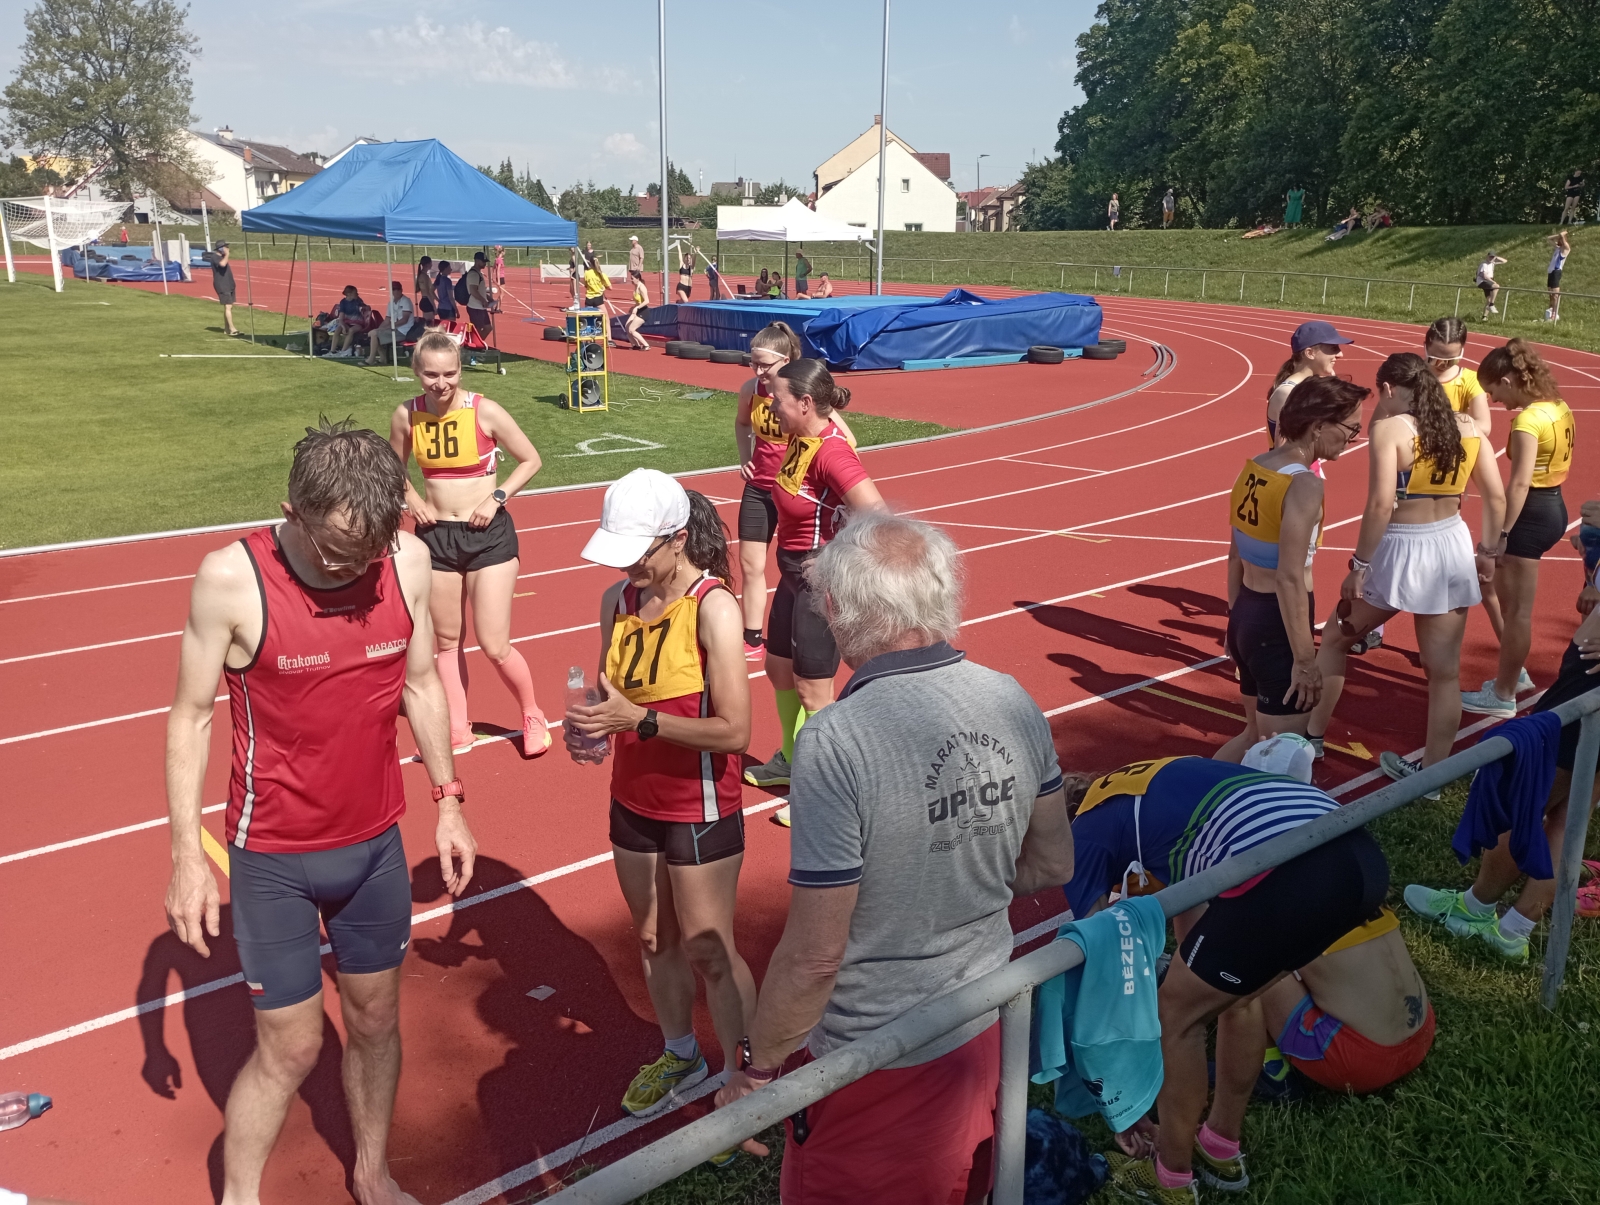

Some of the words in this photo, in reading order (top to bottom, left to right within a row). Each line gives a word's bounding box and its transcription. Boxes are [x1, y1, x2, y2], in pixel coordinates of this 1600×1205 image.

[425, 420, 459, 460] 36
[1236, 473, 1268, 527] 25
[277, 651, 331, 670] Krakonoš
[365, 637, 407, 654] MARATON
[623, 618, 671, 690] 27
[924, 731, 1014, 791] MARATONSTAV
[927, 776, 1016, 825] ÚPICE
[1095, 1095, 1121, 1107] heus
